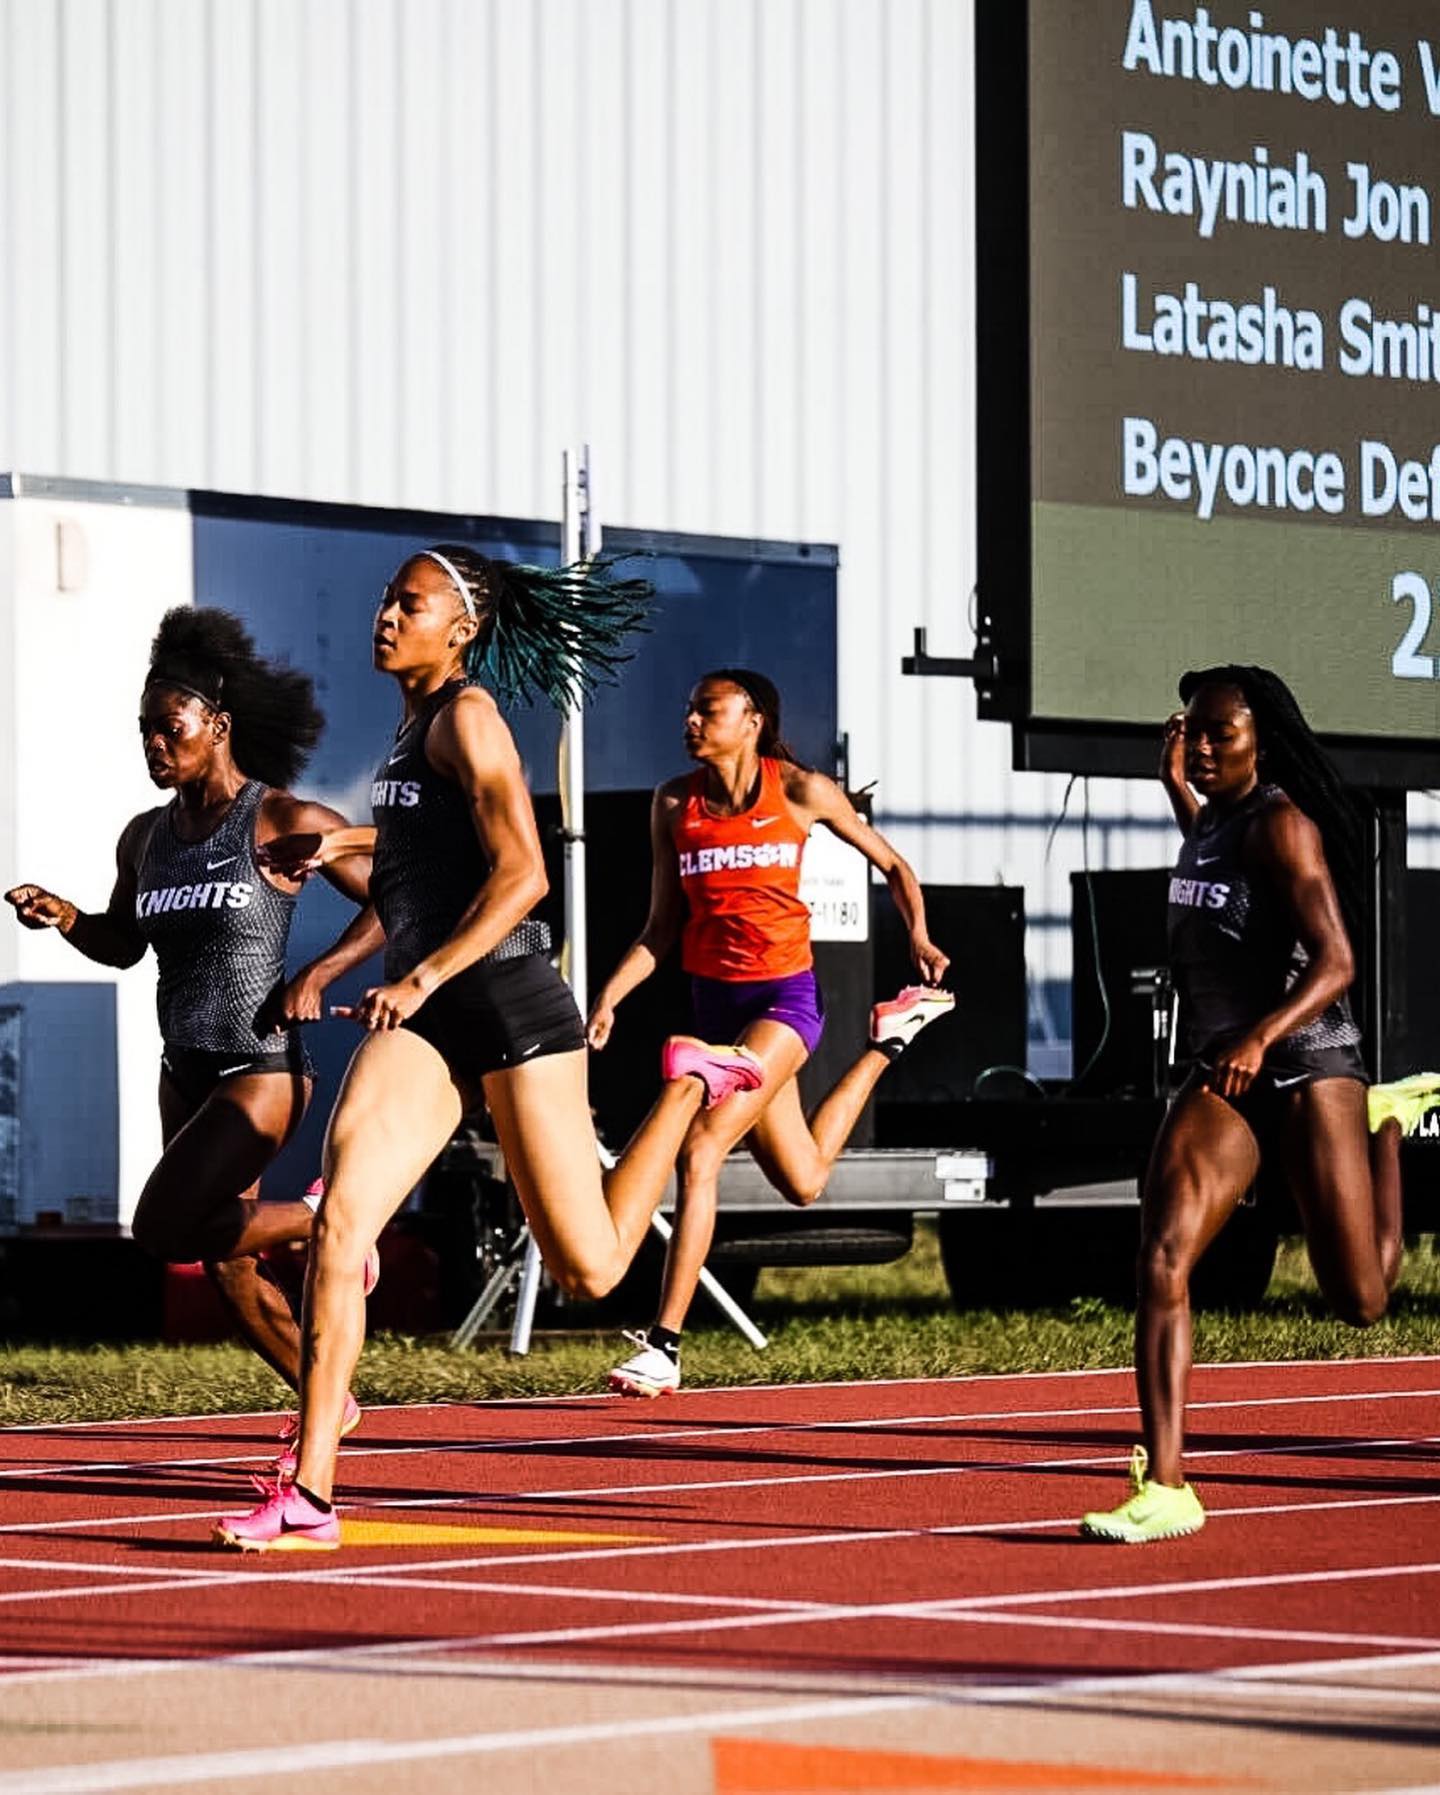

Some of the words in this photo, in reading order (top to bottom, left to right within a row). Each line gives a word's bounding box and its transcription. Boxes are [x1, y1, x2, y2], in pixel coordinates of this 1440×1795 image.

[1122, 0, 1401, 111] Antoinette
[1122, 131, 1327, 237] Rayniah
[1343, 162, 1430, 244] Jon
[1122, 271, 1324, 370] Latasha
[1122, 417, 1346, 519] Beyonce
[1391, 571, 1440, 678] 2
[136, 881, 254, 919] KNIGHTS
[679, 843, 799, 877] CLEMSON
